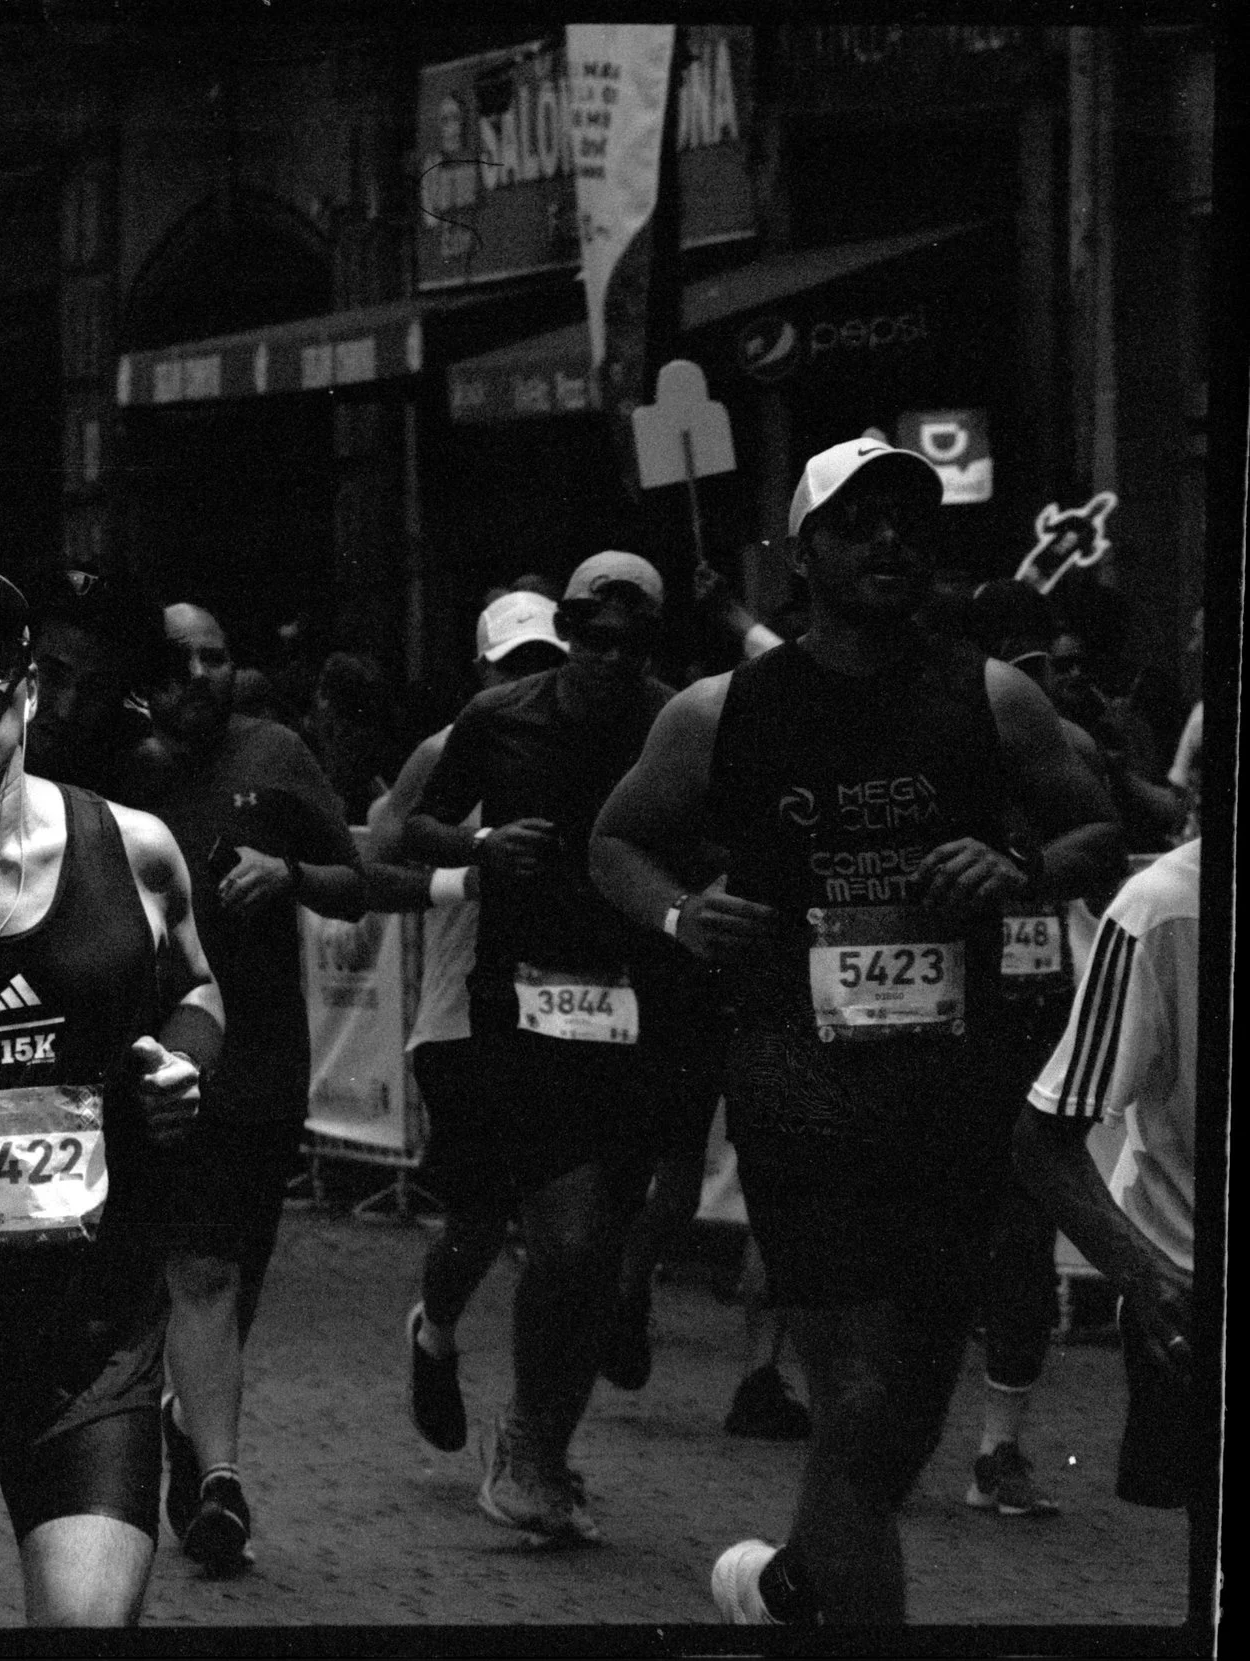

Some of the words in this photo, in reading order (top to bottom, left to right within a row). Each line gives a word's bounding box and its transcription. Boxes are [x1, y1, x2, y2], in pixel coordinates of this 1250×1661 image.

[810, 303, 928, 362] pepsi
[839, 948, 945, 987] 5423
[538, 989, 613, 1016] 3844
